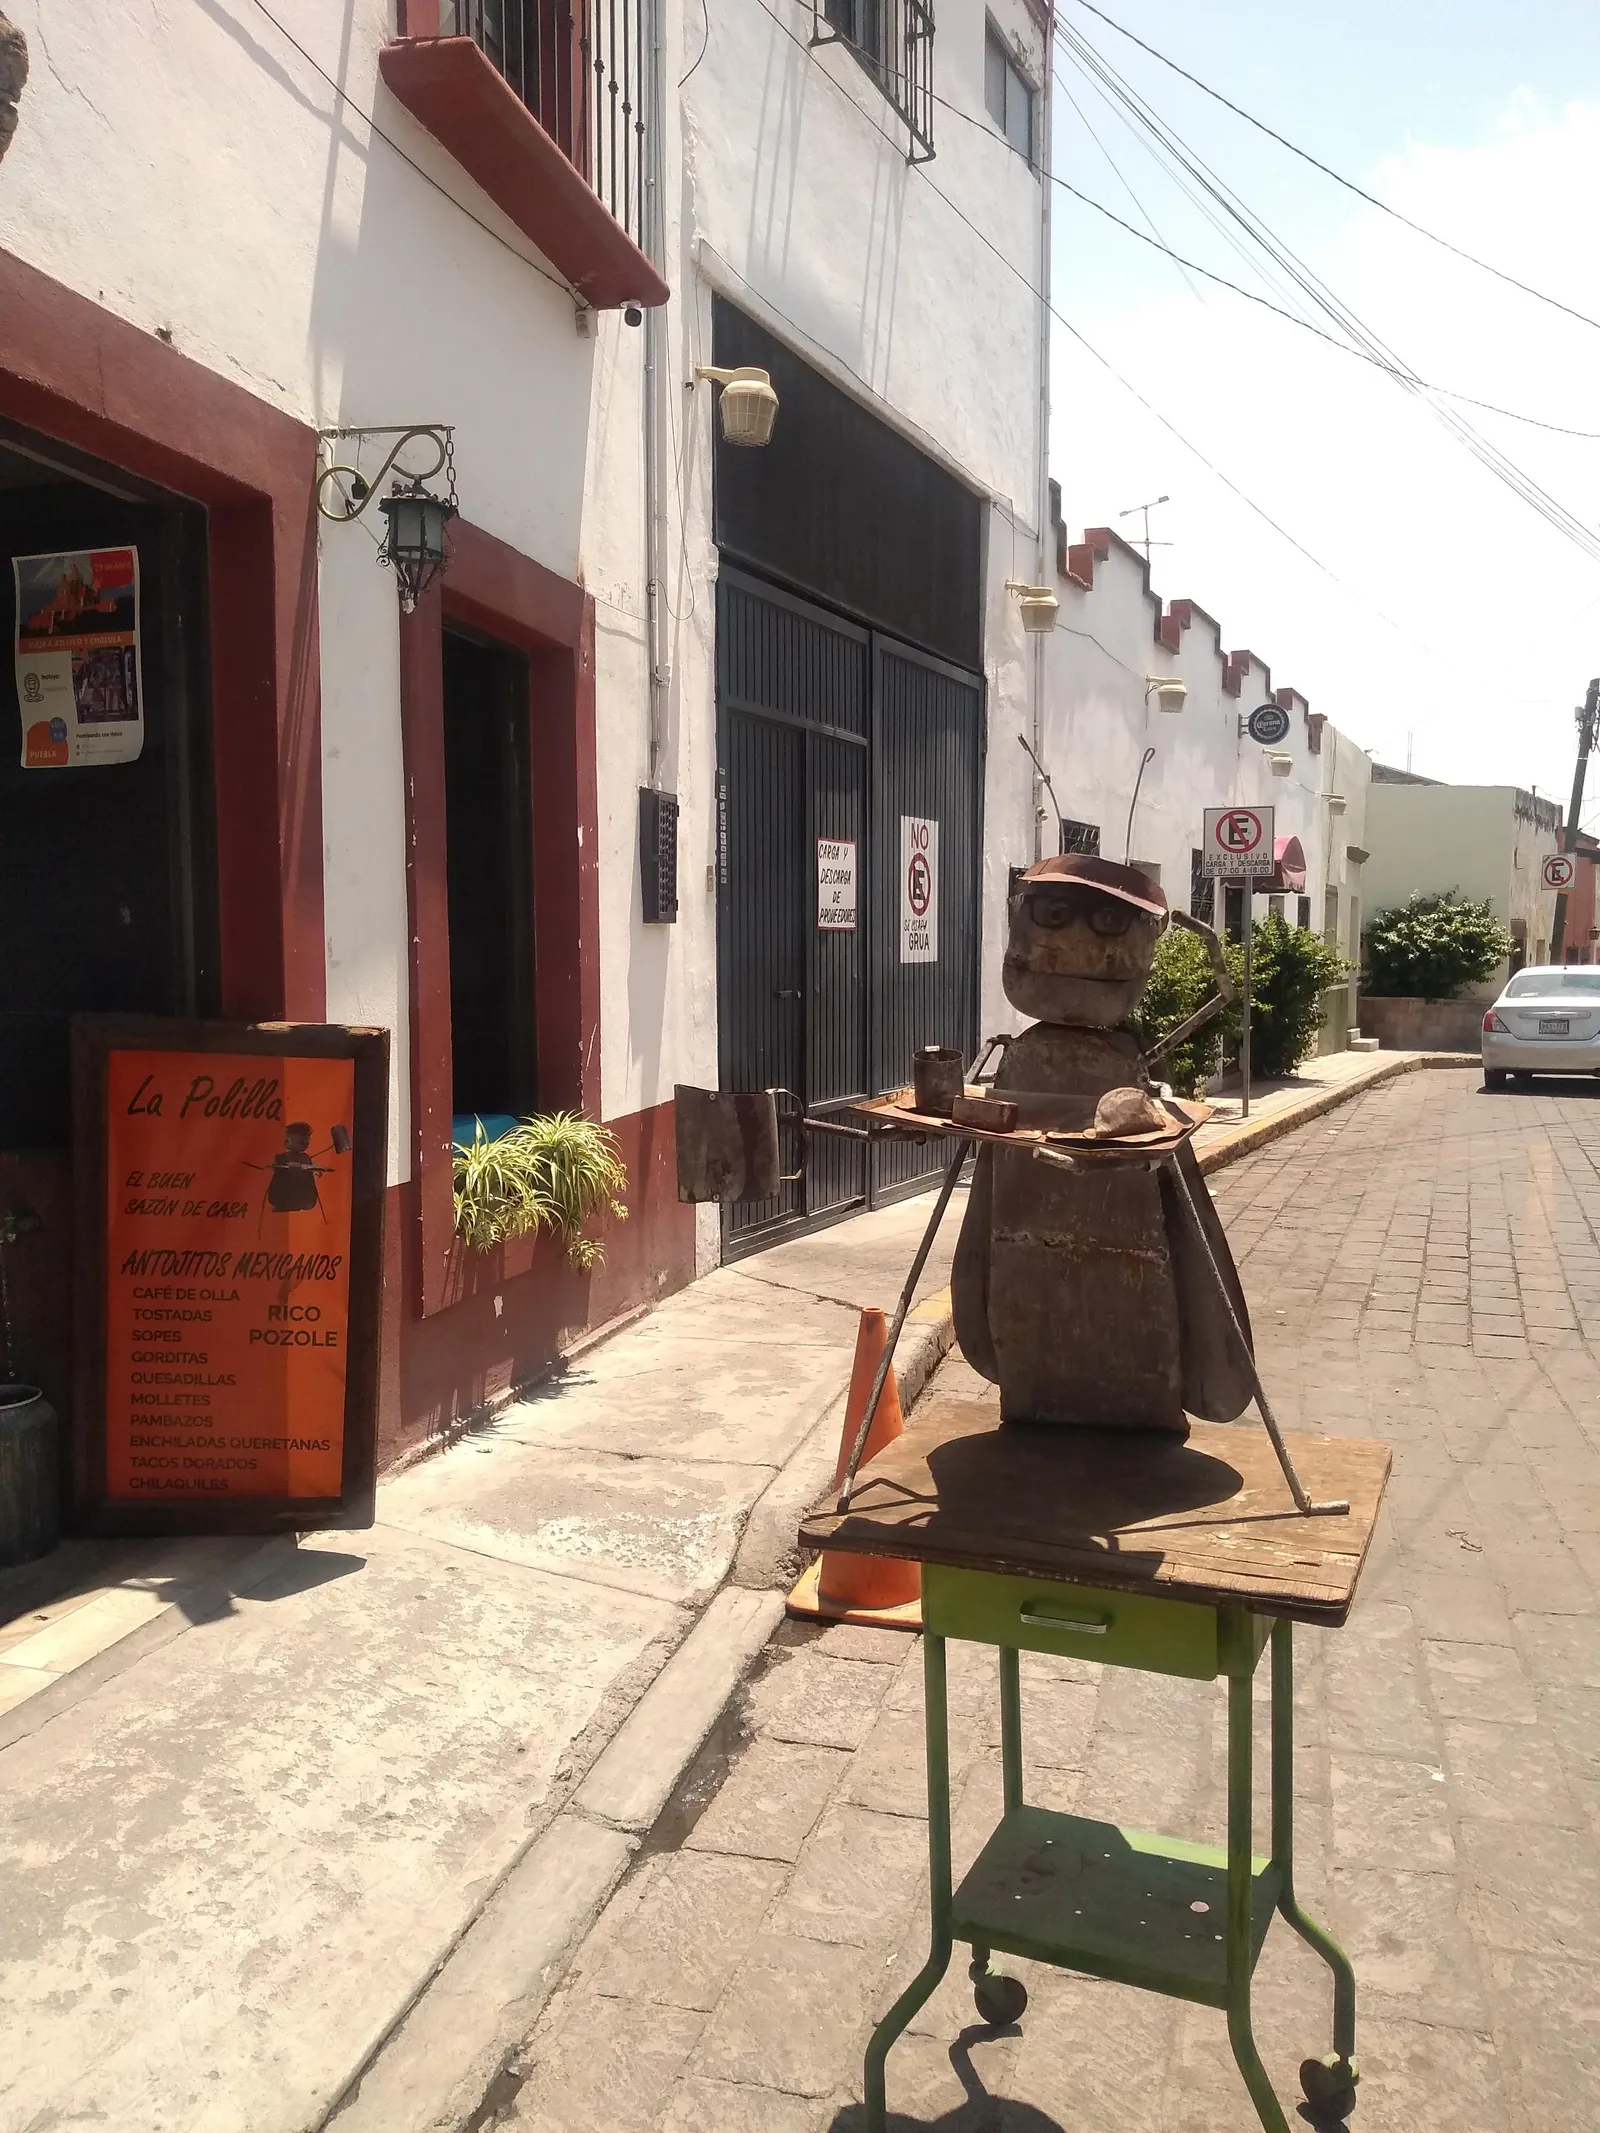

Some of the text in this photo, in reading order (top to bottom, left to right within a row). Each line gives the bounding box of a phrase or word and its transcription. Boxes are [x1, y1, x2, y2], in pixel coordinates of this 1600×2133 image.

[90, 635, 122, 645] CHOLULA
[1256, 720, 1281, 728] Corona
[30, 750, 57, 759] PUEBLA
[911, 823, 929, 850] NO
[819, 844, 849, 861] CARGA Y
[1208, 853, 1268, 861] EXCLUSIVO
[1205, 860, 1226, 868] CARGA
[820, 868, 851, 886] DESCARGA
[832, 891, 842, 904] DE
[908, 932, 930, 951] GRUA
[126, 1074, 283, 1121] La Polilla
[126, 1170, 196, 1190] EL BUEN
[124, 1197, 249, 1218] SAZÓN DE CASA
[120, 1249, 343, 1281] ANTOJITOS MEXICANOS
[133, 1284, 240, 1302] CAFÉ DE OLLA
[133, 1308, 212, 1322] TOSTADAS
[268, 1305, 321, 1323] RICO
[132, 1329, 182, 1343] SOPES
[249, 1328, 338, 1347] POZOLE
[131, 1351, 208, 1365] GORDITAS
[131, 1372, 236, 1387] QUESADILLAS
[131, 1393, 211, 1407] MOLLETES
[130, 1414, 214, 1428] PAMBAZOS
[129, 1436, 331, 1452] ENCHILADAS QUERETANAS
[129, 1456, 257, 1471] TACOS DORADOS
[128, 1477, 229, 1491] CHILAQUILES
